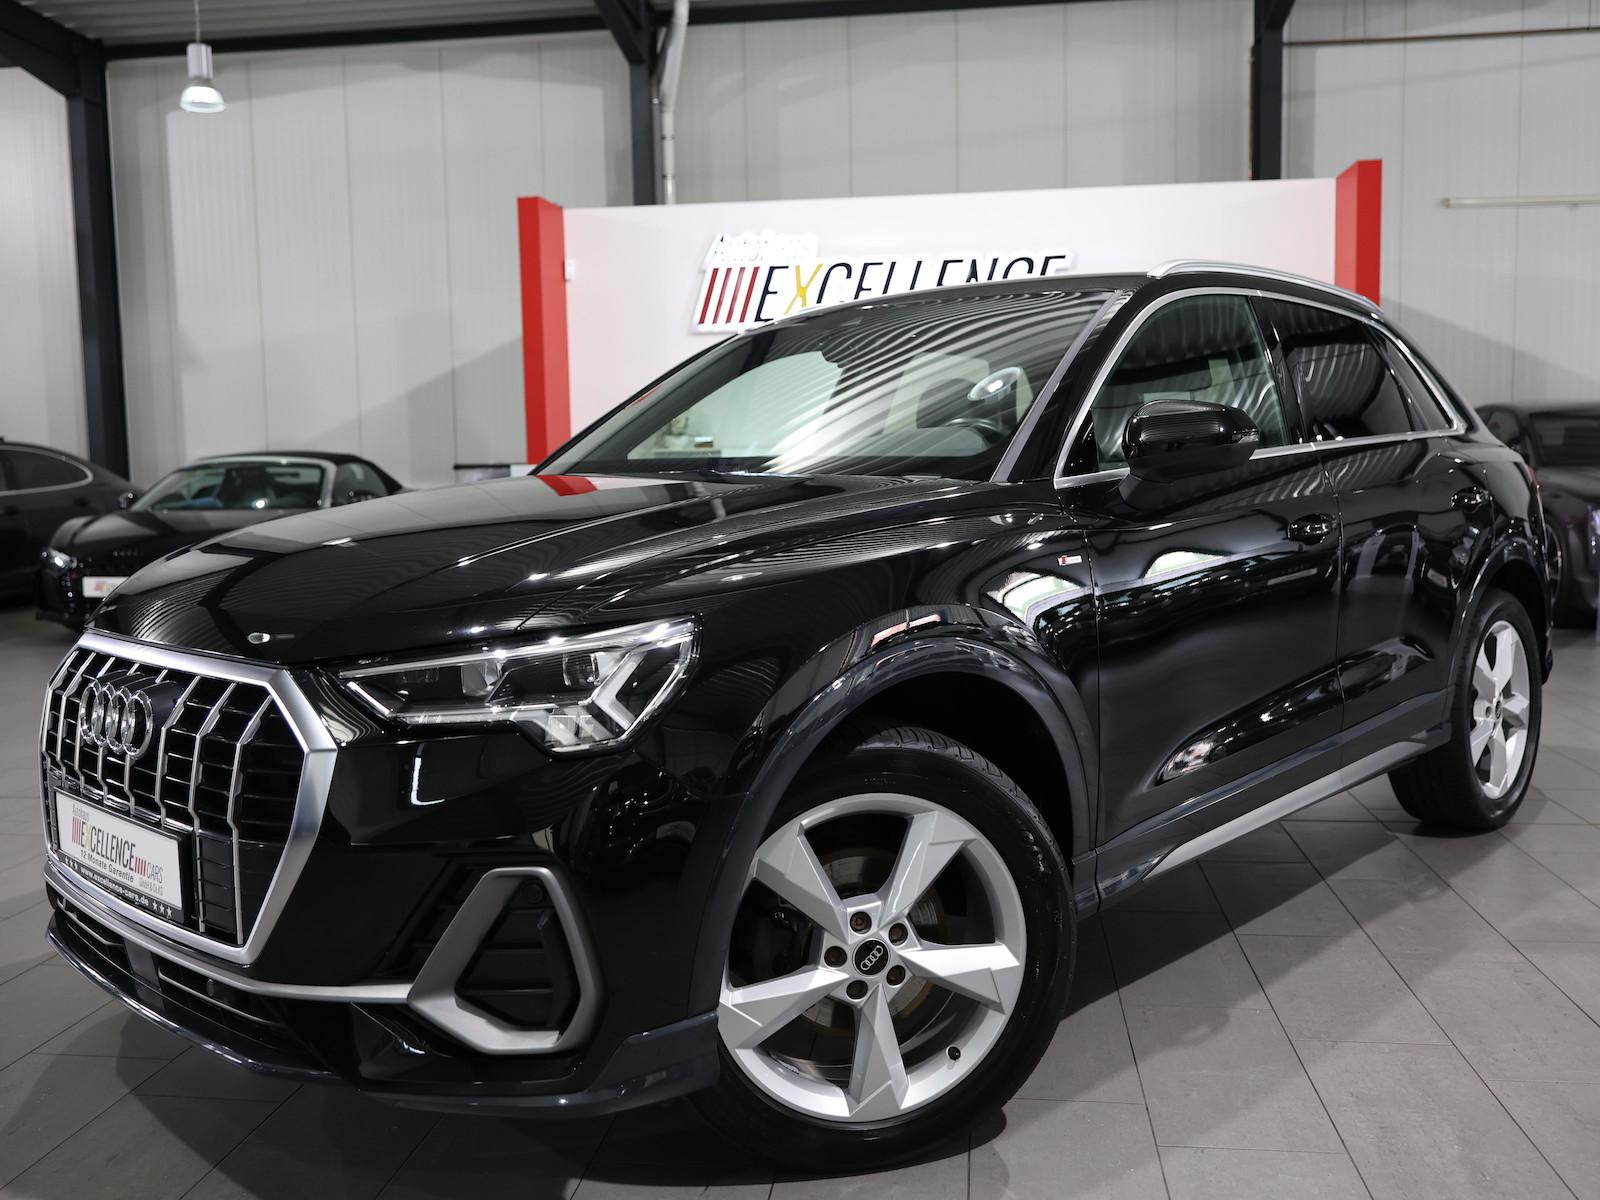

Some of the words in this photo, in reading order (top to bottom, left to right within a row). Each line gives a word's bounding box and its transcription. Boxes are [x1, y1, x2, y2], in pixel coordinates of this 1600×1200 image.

[80, 821, 136, 872] EXCELLENCE
[146, 862, 164, 884] CARS
[80, 850, 87, 859] 12
[88, 854, 108, 870] Monate
[109, 863, 134, 883] Garantie
[80, 866, 149, 906] www.excellence-cars.de
